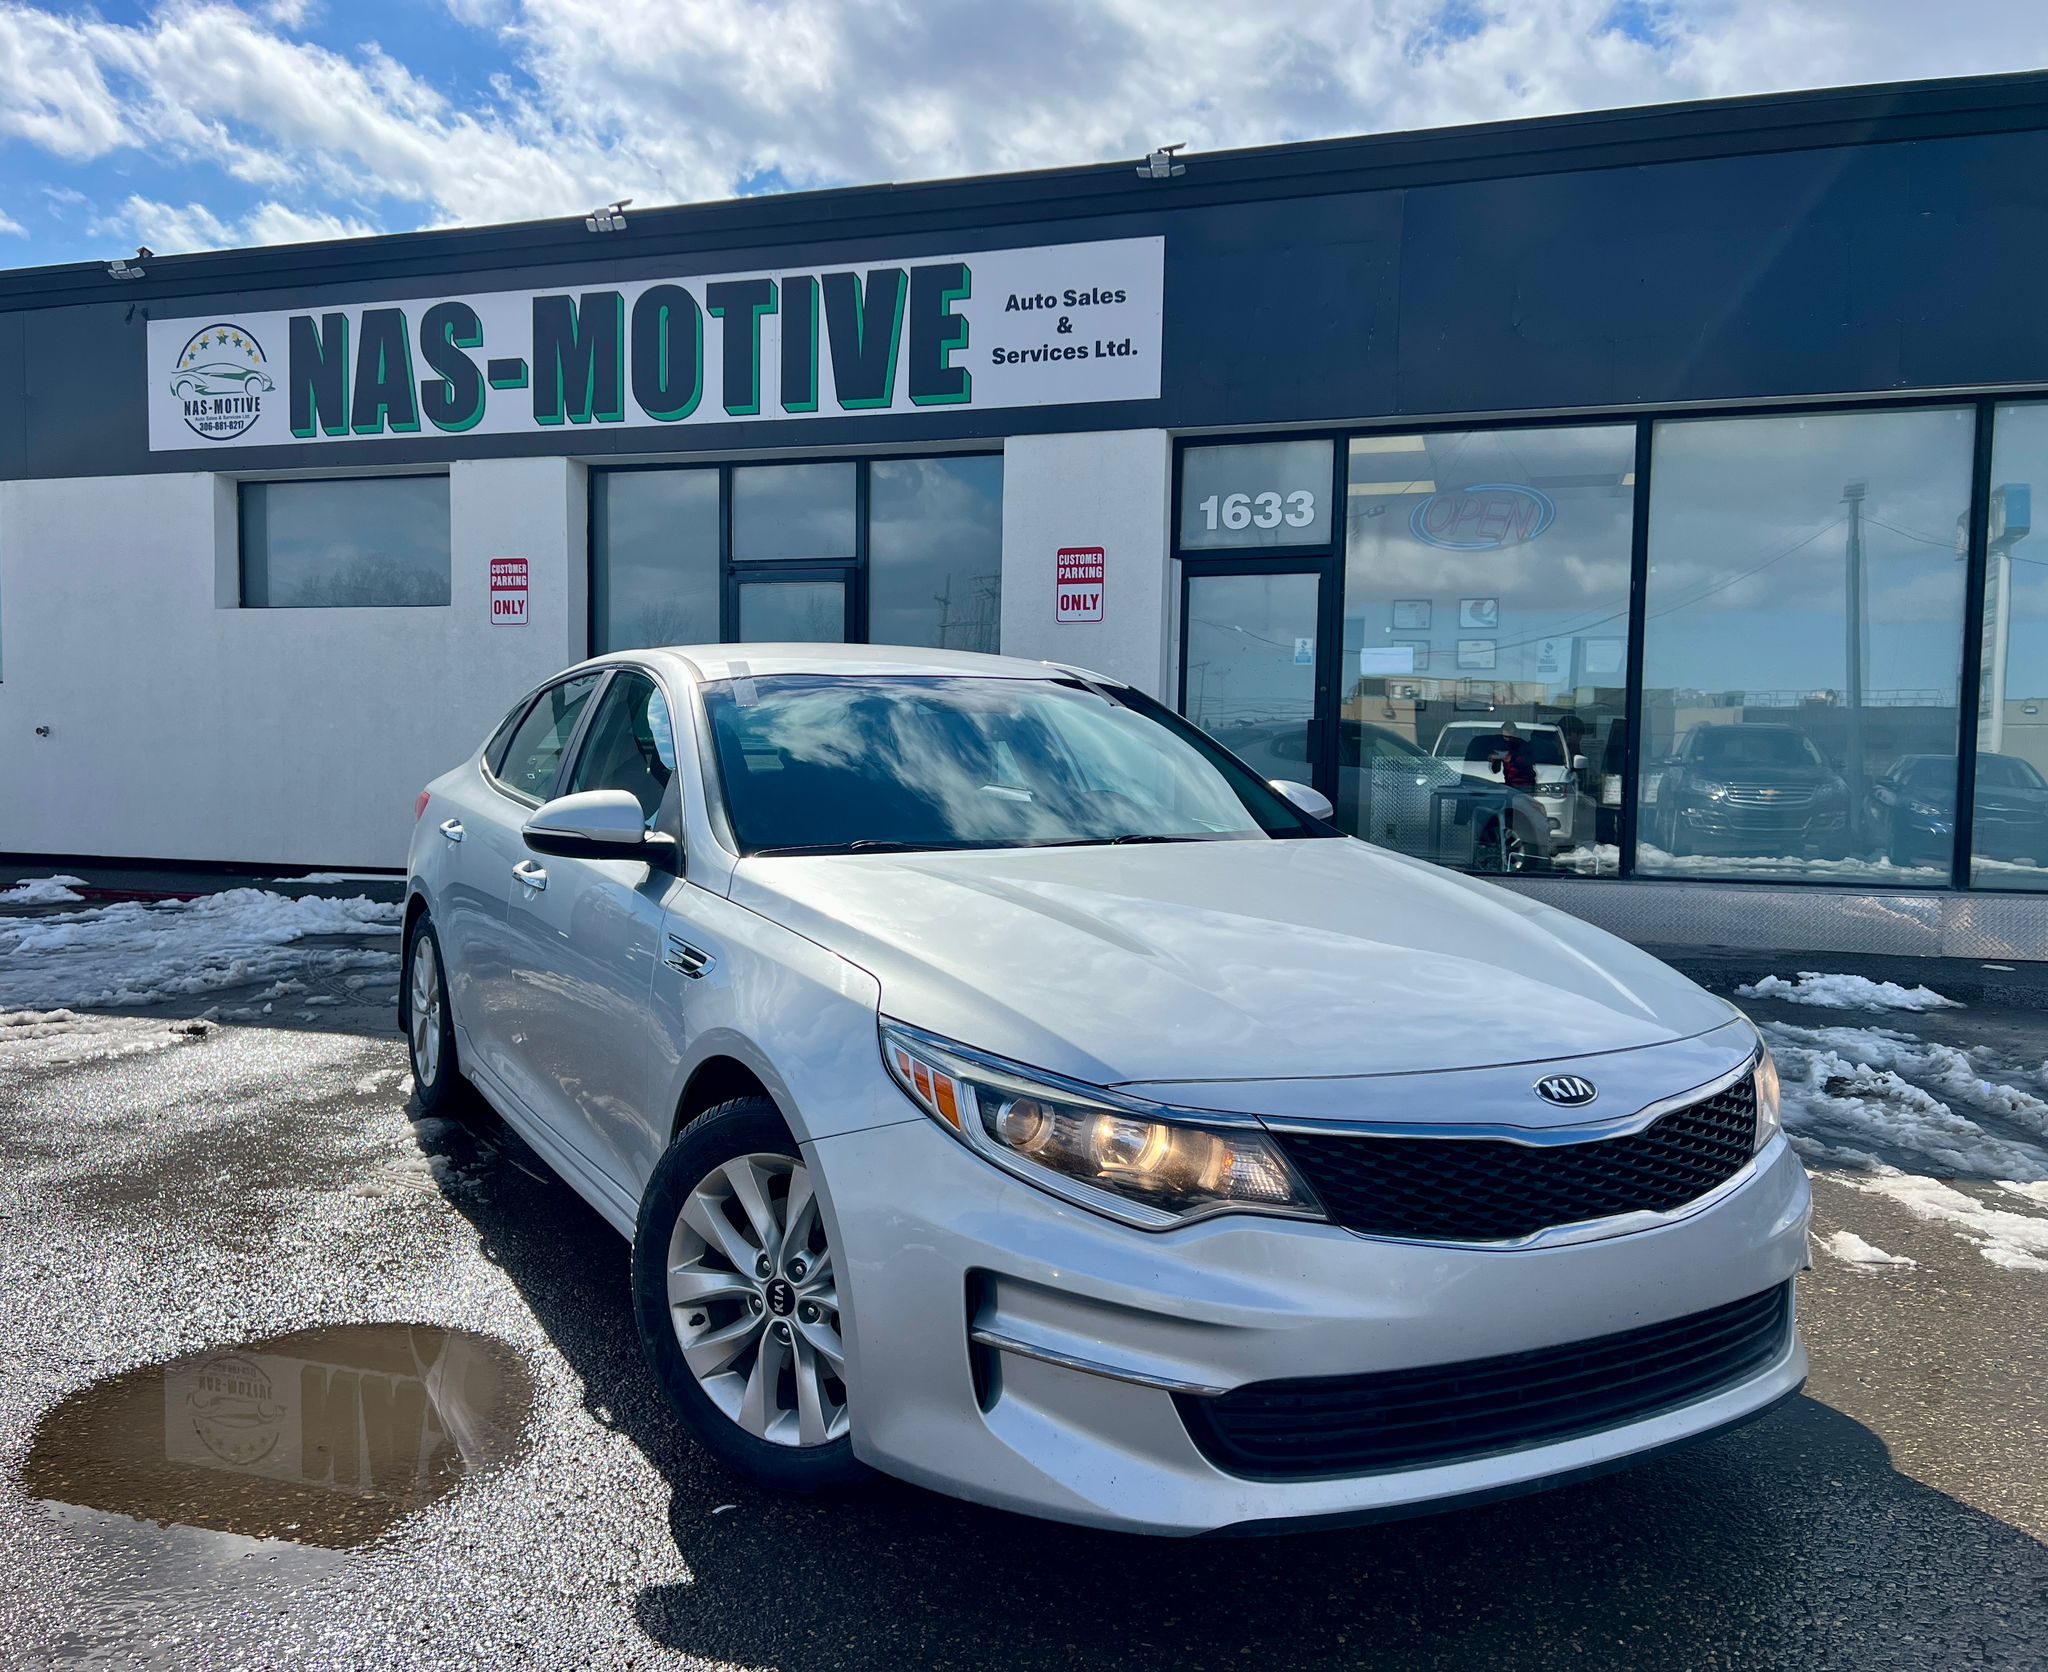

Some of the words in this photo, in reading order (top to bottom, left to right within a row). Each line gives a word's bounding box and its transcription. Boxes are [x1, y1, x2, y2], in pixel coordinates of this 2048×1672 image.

[1005, 293, 1058, 312] Auto
[1063, 287, 1126, 307] Sales
[1056, 316, 1073, 334] &
[289, 262, 972, 438] NAS-MOTIVE
[992, 344, 1089, 365] Services
[1095, 338, 1138, 358] Ltd.
[184, 397, 261, 416] NAS-MOTIVE
[1199, 490, 1315, 530] 1633
[1426, 496, 1536, 541] OPEN
[491, 563, 527, 574] CUSTOMER
[1058, 553, 1103, 565] CUSTOMER
[491, 575, 527, 586] PARKING
[1058, 566, 1103, 579] PARKING
[494, 599, 525, 615] ONLY
[1060, 594, 1100, 611] ONLY
[1542, 1077, 1594, 1099] KIA
[774, 1284, 785, 1313] KIA
